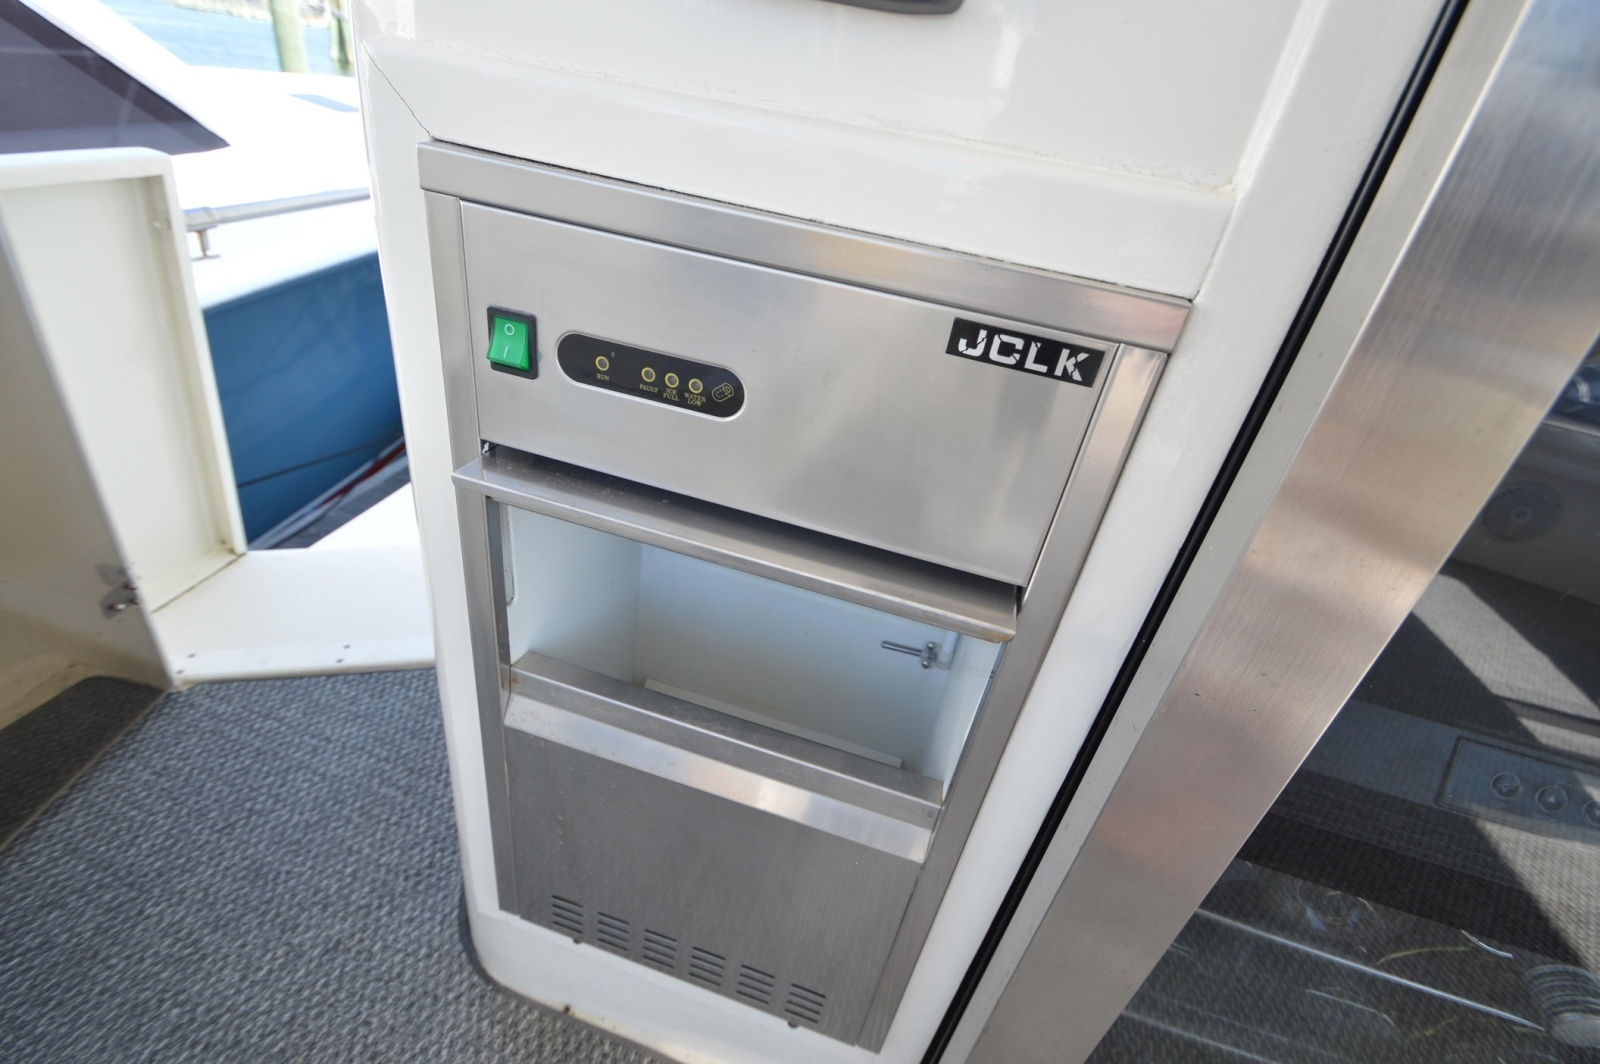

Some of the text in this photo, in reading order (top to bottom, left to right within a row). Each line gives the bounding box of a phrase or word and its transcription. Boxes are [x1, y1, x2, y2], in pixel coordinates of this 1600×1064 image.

[958, 329, 1090, 382] JCLK
[596, 373, 610, 381] RUN
[639, 384, 659, 393] FAULT
[666, 388, 678, 396] ICE
[663, 392, 680, 401] FULL
[684, 392, 707, 402] WATER
[687, 398, 702, 406] LOW
